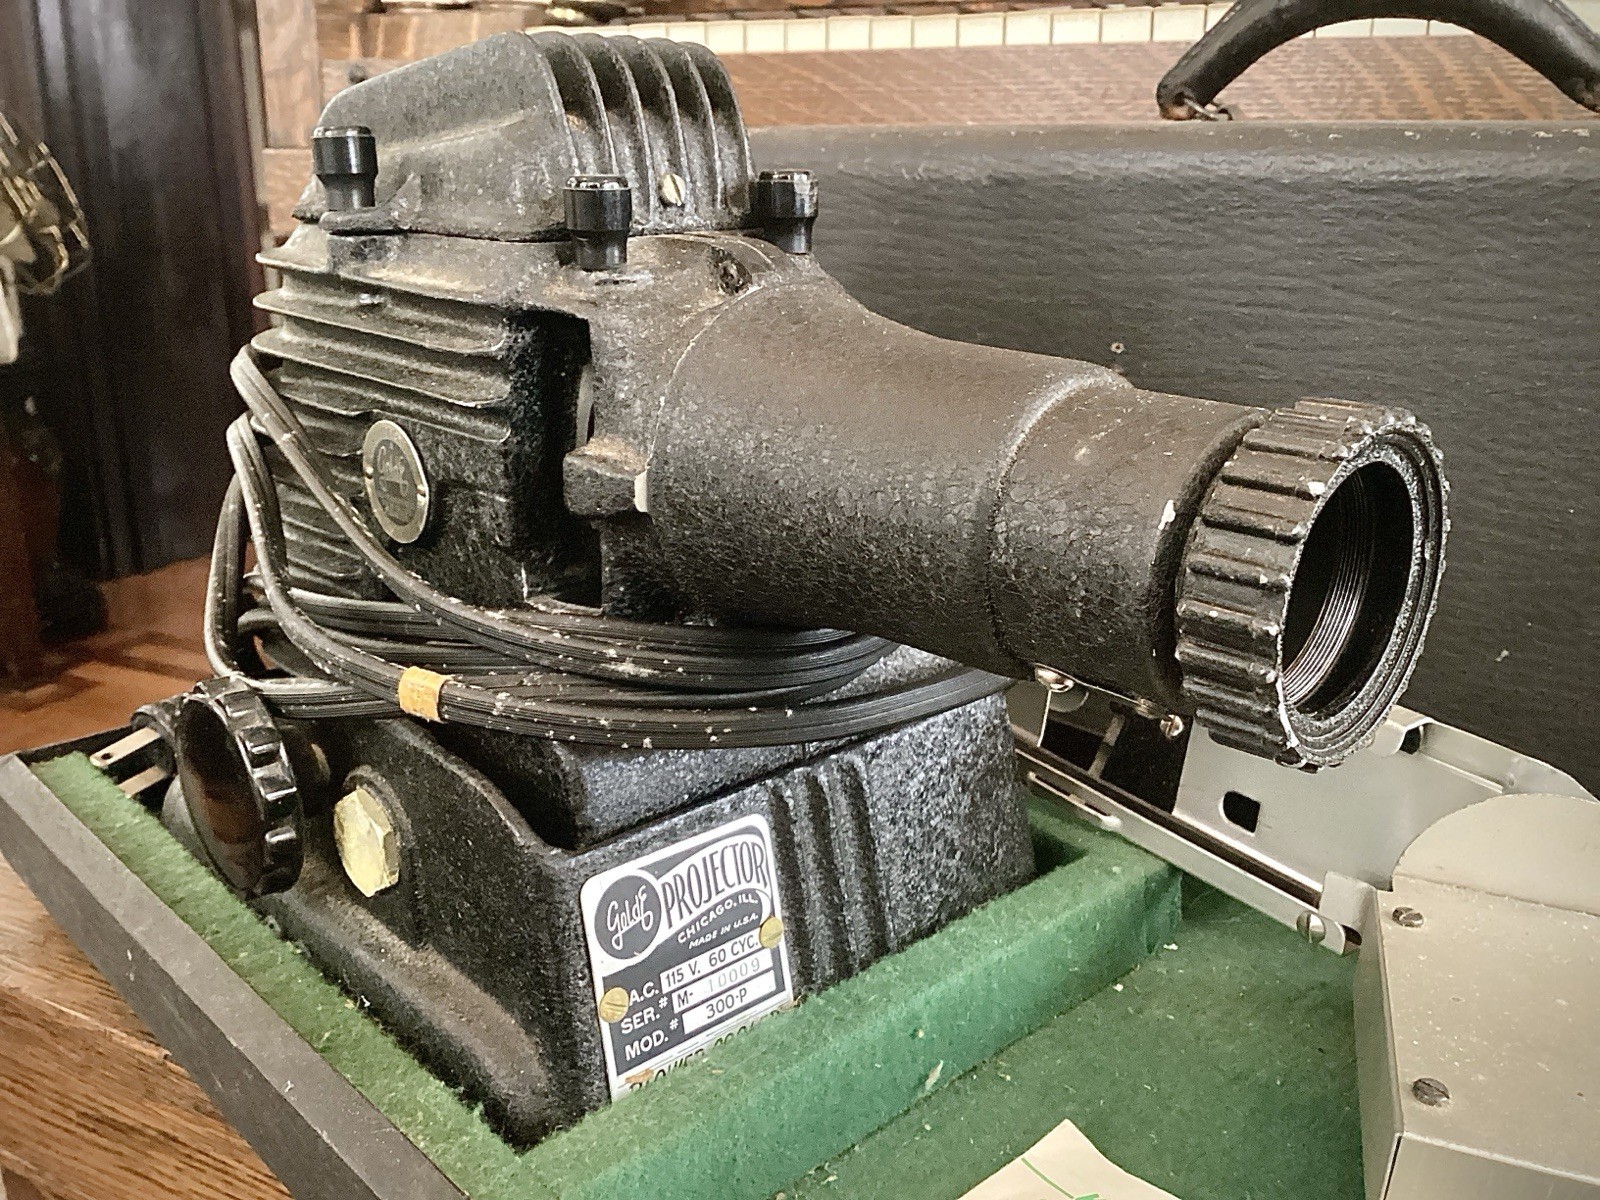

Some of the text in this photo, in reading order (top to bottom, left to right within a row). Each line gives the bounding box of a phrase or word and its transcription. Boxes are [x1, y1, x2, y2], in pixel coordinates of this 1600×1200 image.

[661, 841, 768, 929] PROJECTOR
[688, 912, 759, 949] MADE IN U.S.A.
[629, 934, 758, 1007] A.C. 115 V. 60 CYC.
[677, 990, 693, 1008] M-
[708, 957, 760, 992] 10009
[625, 1030, 668, 1061] MOD.
[706, 987, 747, 1019] 300-P
